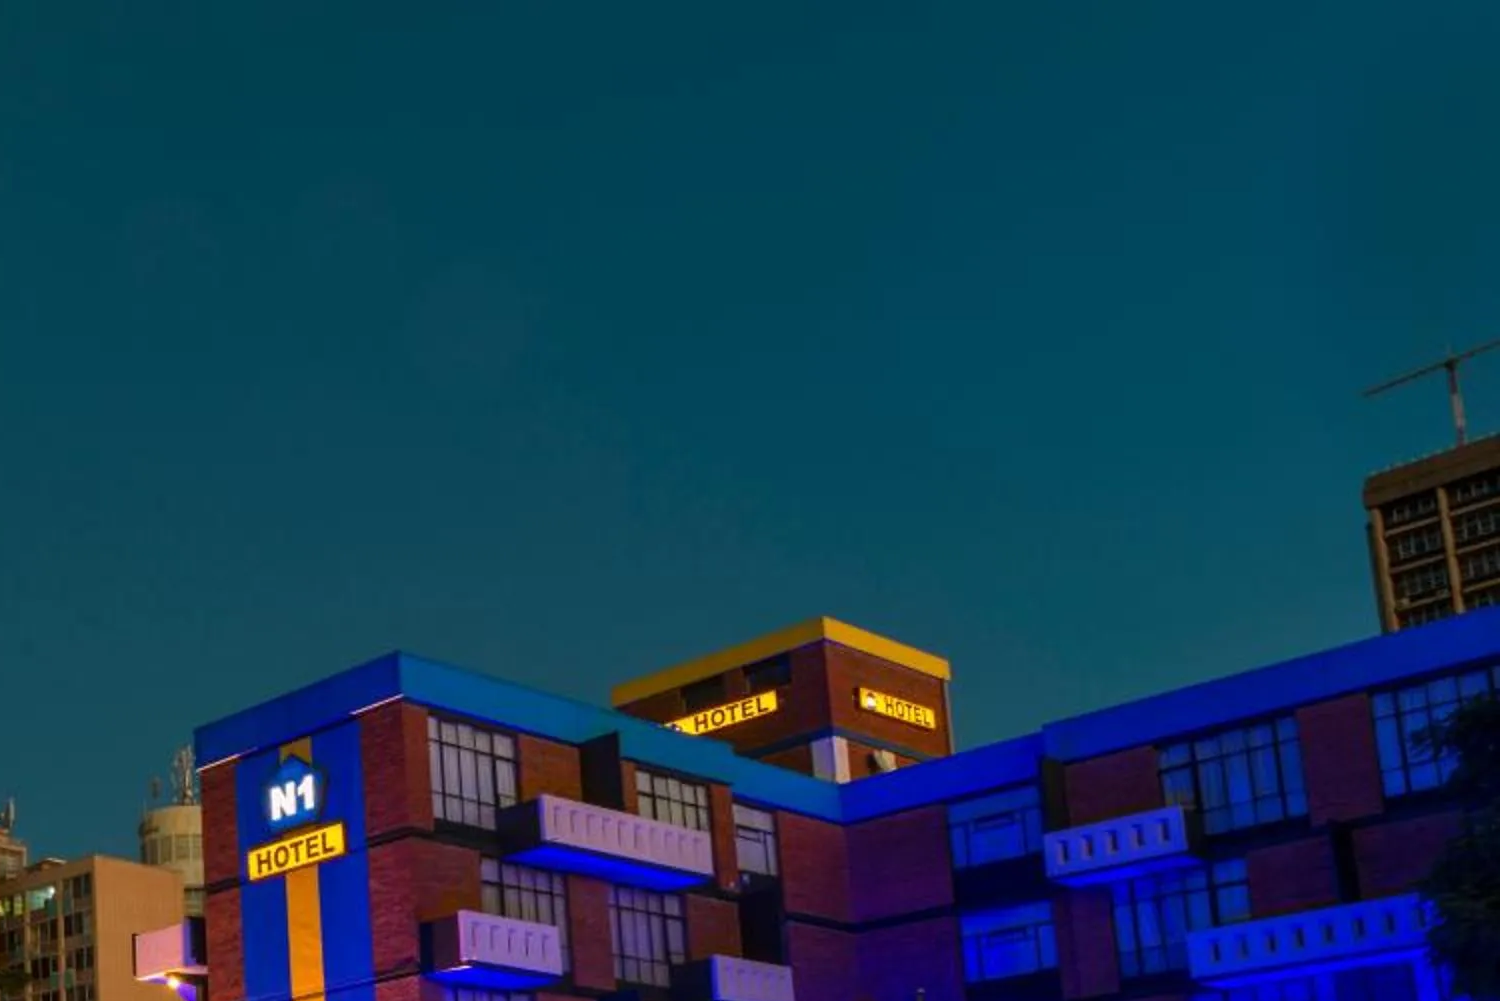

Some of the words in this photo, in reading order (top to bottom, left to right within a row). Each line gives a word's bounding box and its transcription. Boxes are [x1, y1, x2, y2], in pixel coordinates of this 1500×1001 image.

[694, 697, 769, 732] HOTEL
[884, 696, 931, 726] HOTEL
[269, 774, 315, 821] N1
[257, 832, 336, 873] HOTEL
